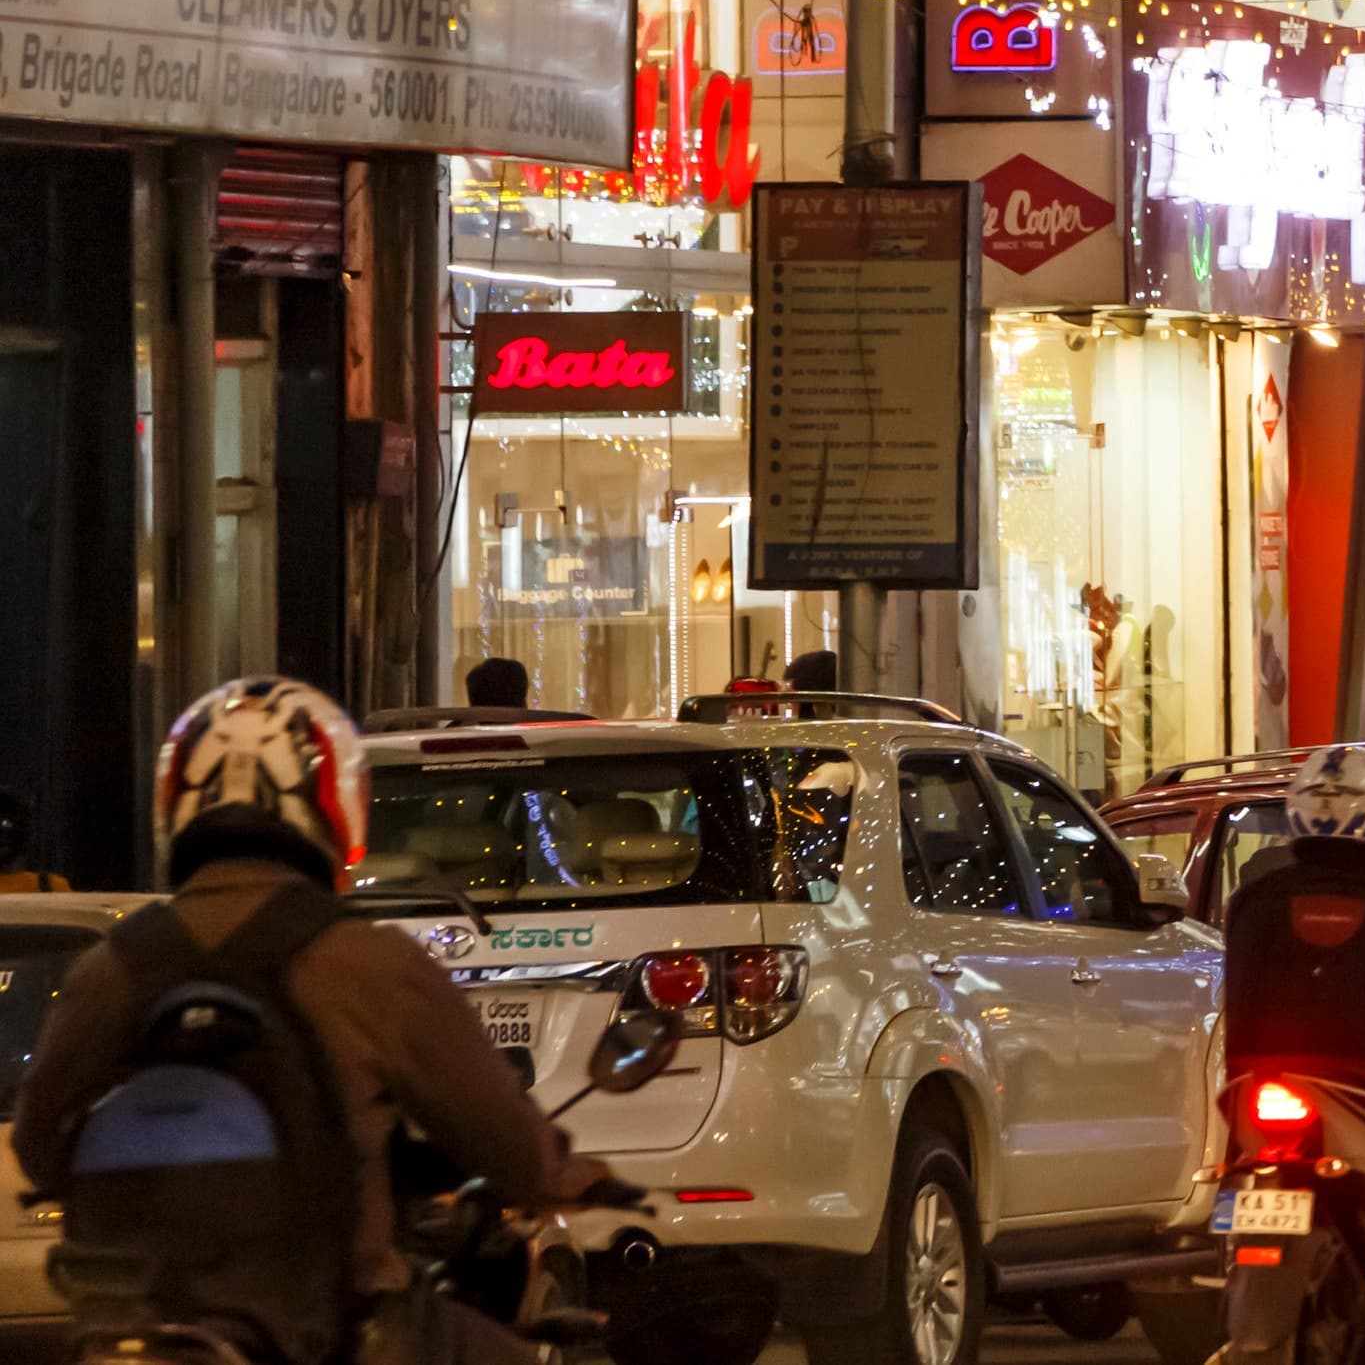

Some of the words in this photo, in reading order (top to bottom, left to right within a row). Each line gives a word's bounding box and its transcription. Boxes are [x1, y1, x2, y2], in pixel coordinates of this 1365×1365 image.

[20, 32, 124, 108] Brigade
[222, 55, 346, 126] Bangalore
[780, 197, 823, 215] PAY
[1004, 189, 1095, 247] Cooper
[488, 337, 676, 390] Bata
